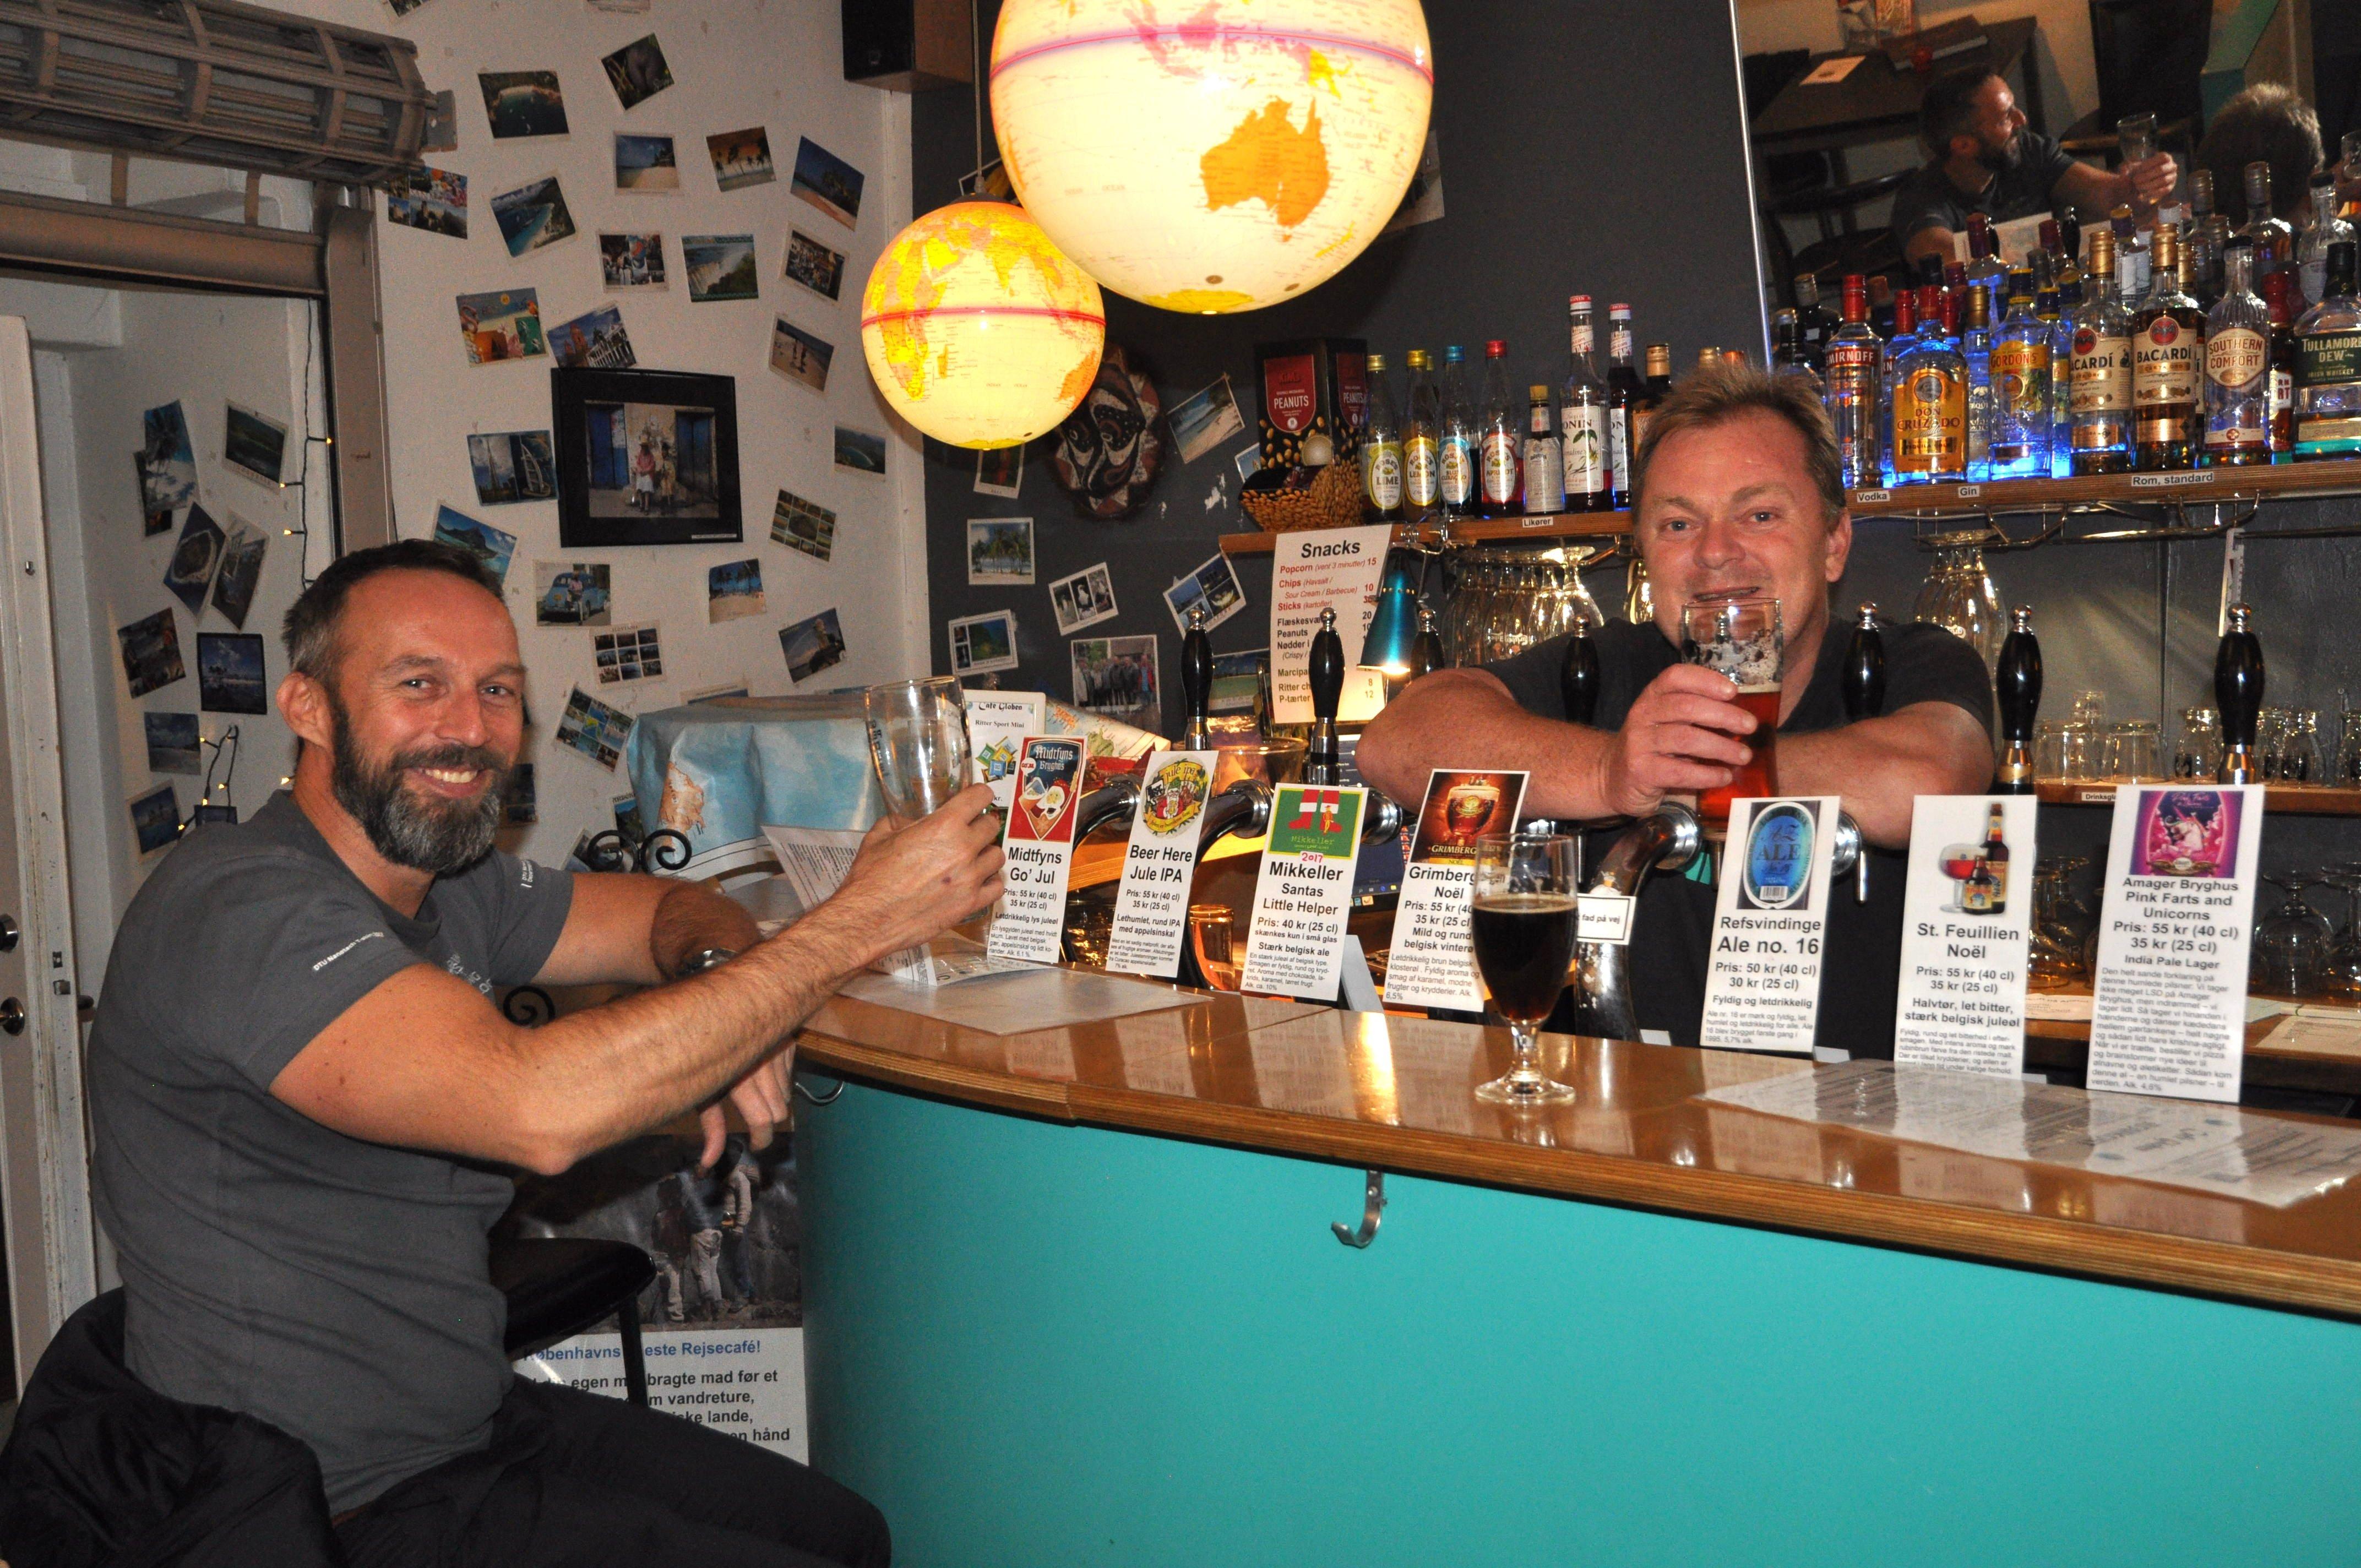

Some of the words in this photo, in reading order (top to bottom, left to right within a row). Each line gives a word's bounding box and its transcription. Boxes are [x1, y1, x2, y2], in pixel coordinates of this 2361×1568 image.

[2208, 338, 2262, 355] SOUTHERN
[2137, 345, 2191, 363] BACARDÍ
[2319, 350, 2344, 362] DEW
[2210, 355, 2261, 368] COMFORT
[1274, 395, 1309, 409] PEANUTS
[1916, 408, 1940, 417] DON
[1377, 476, 1399, 484] LIME
[2133, 477, 2160, 485] Rom,
[2164, 473, 2213, 483] standard
[1858, 492, 1887, 501] Vodka
[1524, 518, 1551, 526] Likører
[1301, 540, 1361, 558] Snacks
[1280, 565, 1313, 575] Popcorn
[1279, 579, 1301, 589] Chips
[1278, 602, 1301, 611] Sticks
[1363, 611, 1372, 619] 20
[1277, 629, 1308, 638] Peanuts
[1280, 695, 1310, 703] P-tærter
[1036, 745, 1073, 763] Midtfyns
[1009, 847, 1062, 866] Midtfyns
[1130, 845, 1160, 859] Beer
[1163, 847, 1192, 862] Here
[1302, 852, 1323, 863] 2017
[1756, 843, 1802, 861] ALE
[1035, 869, 1054, 884] Jul
[1130, 865, 1156, 880] Jule
[1161, 868, 1182, 883] IPA
[1269, 861, 1343, 881] Mikkeller
[1282, 883, 1324, 897] Santas
[2123, 877, 2176, 890] Amager
[2180, 879, 2239, 892] Bryghus
[1004, 888, 1018, 896] Pris:
[1037, 891, 1047, 900] (40
[1048, 893, 1057, 901] cl)
[1160, 892, 1170, 900] (40
[1172, 894, 1180, 902] cl)
[1434, 886, 1464, 899] Noël
[2126, 891, 2157, 903] Pink
[2162, 892, 2199, 905] Farts
[2205, 896, 2232, 906] and
[1263, 898, 1293, 911] Little
[1297, 901, 1338, 916] Helper
[1405, 900, 1428, 911] Pris:
[1431, 902, 1442, 911] 55
[1445, 903, 1455, 912] kr
[995, 912, 1030, 923] Letdrikkelig
[1117, 914, 1150, 925] Lethumlet,
[1169, 919, 1180, 927] IPA
[2144, 907, 2210, 921] Unicorns
[1258, 917, 1279, 927] Pris:
[1282, 919, 1293, 928] 40
[1296, 921, 1306, 929] kr
[1309, 922, 1323, 933] (25
[1326, 924, 1338, 934] cl)
[1721, 917, 1820, 934] Refsvindinge
[1917, 923, 1938, 937] St.
[1945, 924, 2019, 940] Feuillien
[2113, 921, 2146, 933] Pris:
[2152, 923, 2168, 934] 55
[2174, 924, 2188, 934] kr
[2193, 925, 2215, 939] (40
[2220, 927, 2239, 940] cl)
[1135, 928, 1175, 938] appelsinskal
[1255, 929, 1285, 938] skænkes
[1413, 927, 1432, 937] Mild
[1435, 930, 1446, 939] og
[1450, 932, 1472, 940] rund
[1259, 941, 1282, 952] Stærk
[1286, 944, 1315, 955] belgisk
[1405, 939, 1438, 952] belgisk
[1717, 936, 1749, 952] Ale
[1757, 940, 1787, 954] no.
[1797, 938, 1819, 955] 16
[1947, 944, 1985, 959] Noël
[313, 959, 327, 971] DTU
[2125, 955, 2152, 964] India
[2157, 957, 2182, 967] Pale
[2186, 958, 2220, 970] Lager
[1716, 962, 1742, 973] Pris:
[1747, 963, 1760, 973] 50
[1764, 963, 1776, 974] kr
[1780, 964, 1797, 976] (40
[1802, 965, 1816, 978] cl)
[1917, 966, 1942, 977] Pris:
[1946, 968, 1960, 977] 55
[1964, 969, 1975, 978] kr
[1978, 970, 1995, 981] (40
[2000, 971, 2014, 982] cl)
[1713, 995, 1741, 1006] Fyldig
[1744, 998, 1756, 1006] og
[1759, 997, 1812, 1009] letdrikkelig
[1913, 998, 1957, 1010] Halvtør,
[1962, 1001, 1976, 1011] let
[1979, 1002, 2013, 1015] bitter,
[1905, 1012, 1937, 1022] stærk
[1941, 1013, 1984, 1026] belgisk
[1987, 1016, 2020, 1027] juleøl
[682, 1340, 760, 1358] Rejsecafé!
[572, 1378, 608, 1390] egen
[701, 1370, 733, 1384] mad
[738, 1370, 759, 1382] før
[764, 1370, 777, 1382] et
[668, 1391, 754, 1404] vandreture,
[708, 1409, 753, 1424] lande,
[753, 1427, 790, 1441] hånd
